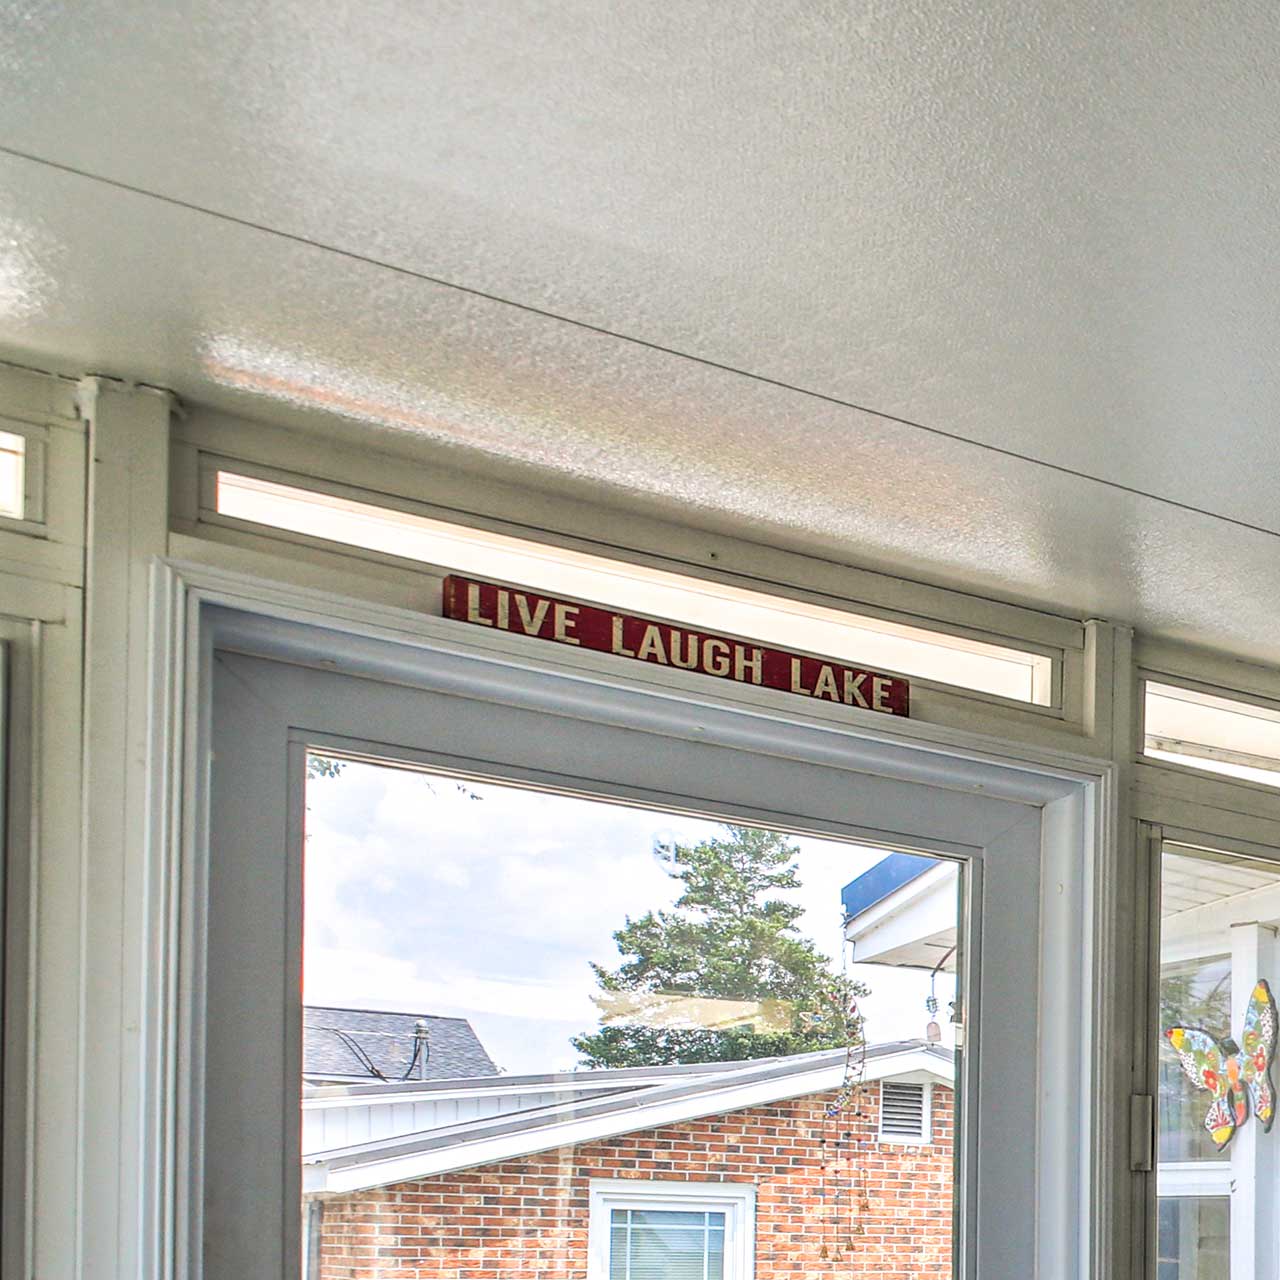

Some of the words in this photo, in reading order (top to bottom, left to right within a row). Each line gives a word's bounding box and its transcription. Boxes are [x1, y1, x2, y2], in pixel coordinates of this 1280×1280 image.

[467, 583, 580, 645] LIVE
[611, 614, 763, 685] LAUGH
[791, 656, 894, 713] LAKE
